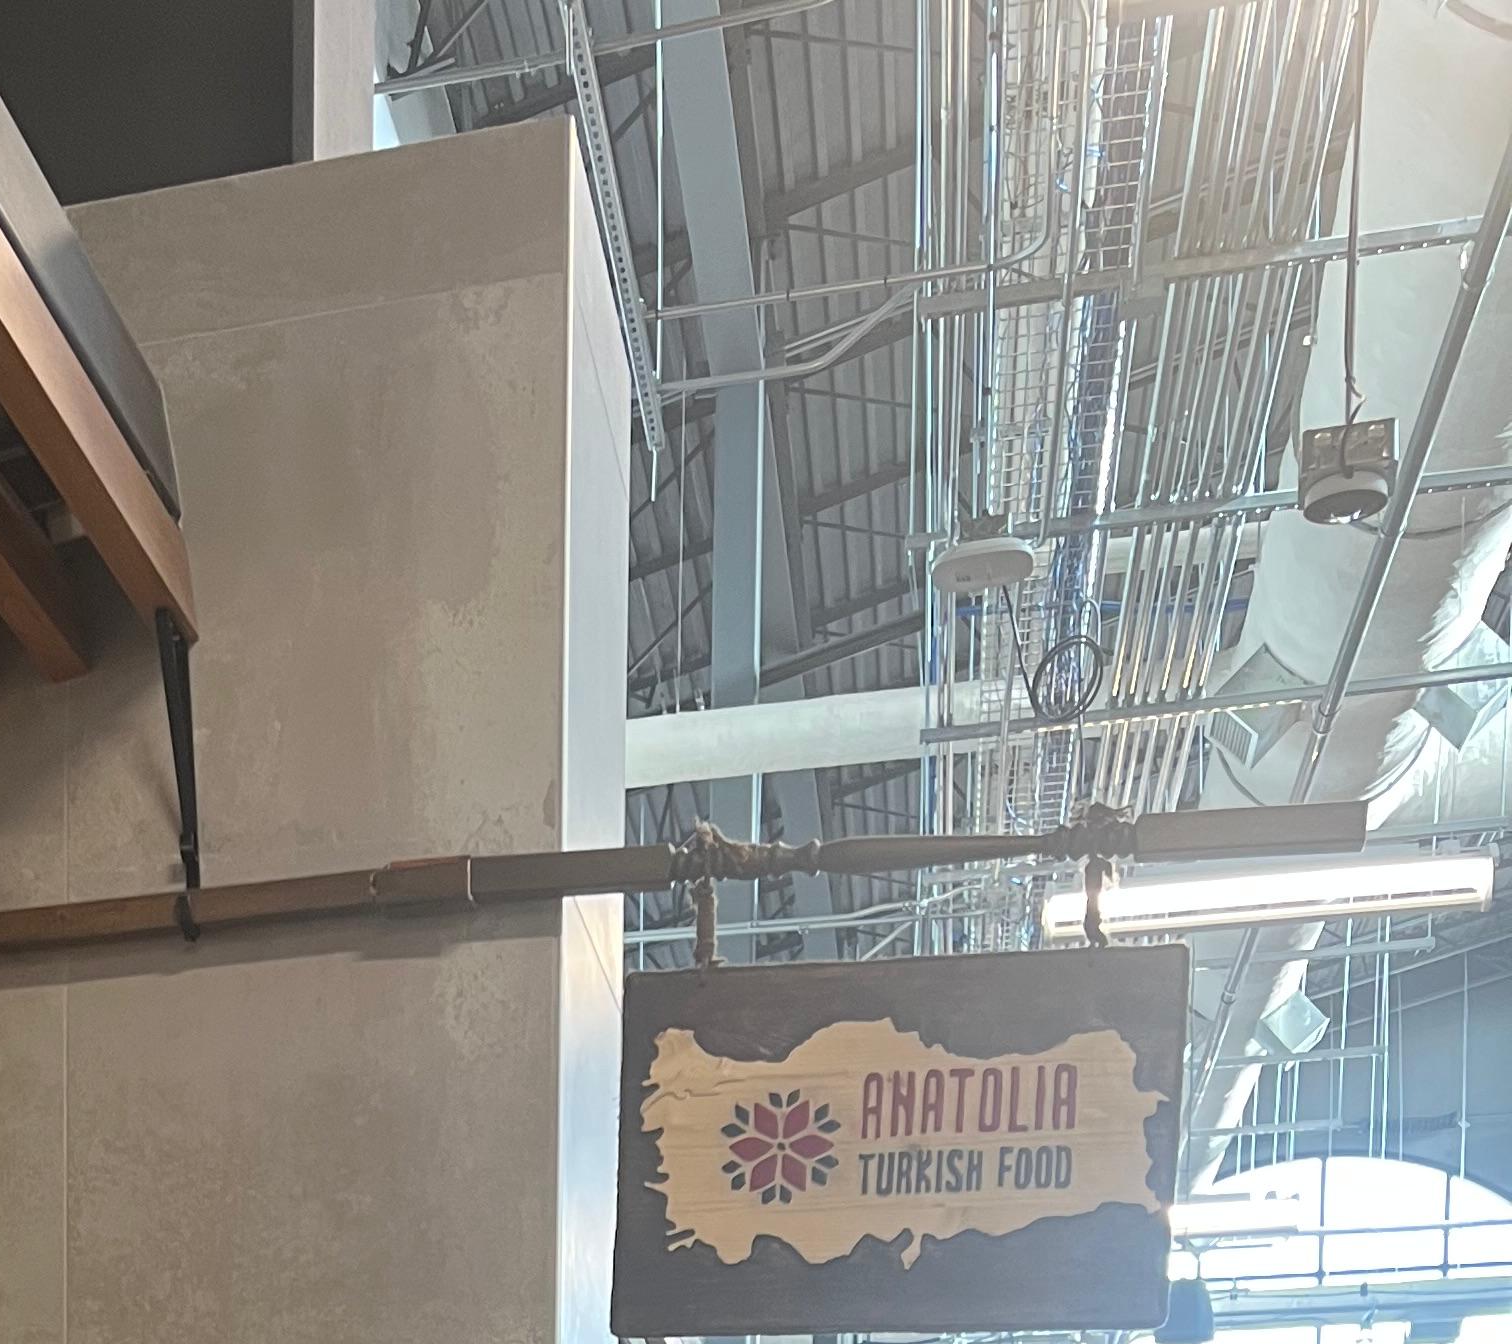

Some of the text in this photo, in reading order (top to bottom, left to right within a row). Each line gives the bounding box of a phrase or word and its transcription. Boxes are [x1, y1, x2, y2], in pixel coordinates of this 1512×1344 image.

[861, 1063, 1078, 1140] ANATOLIA
[858, 1145, 1073, 1196] TURKISH FOOD
